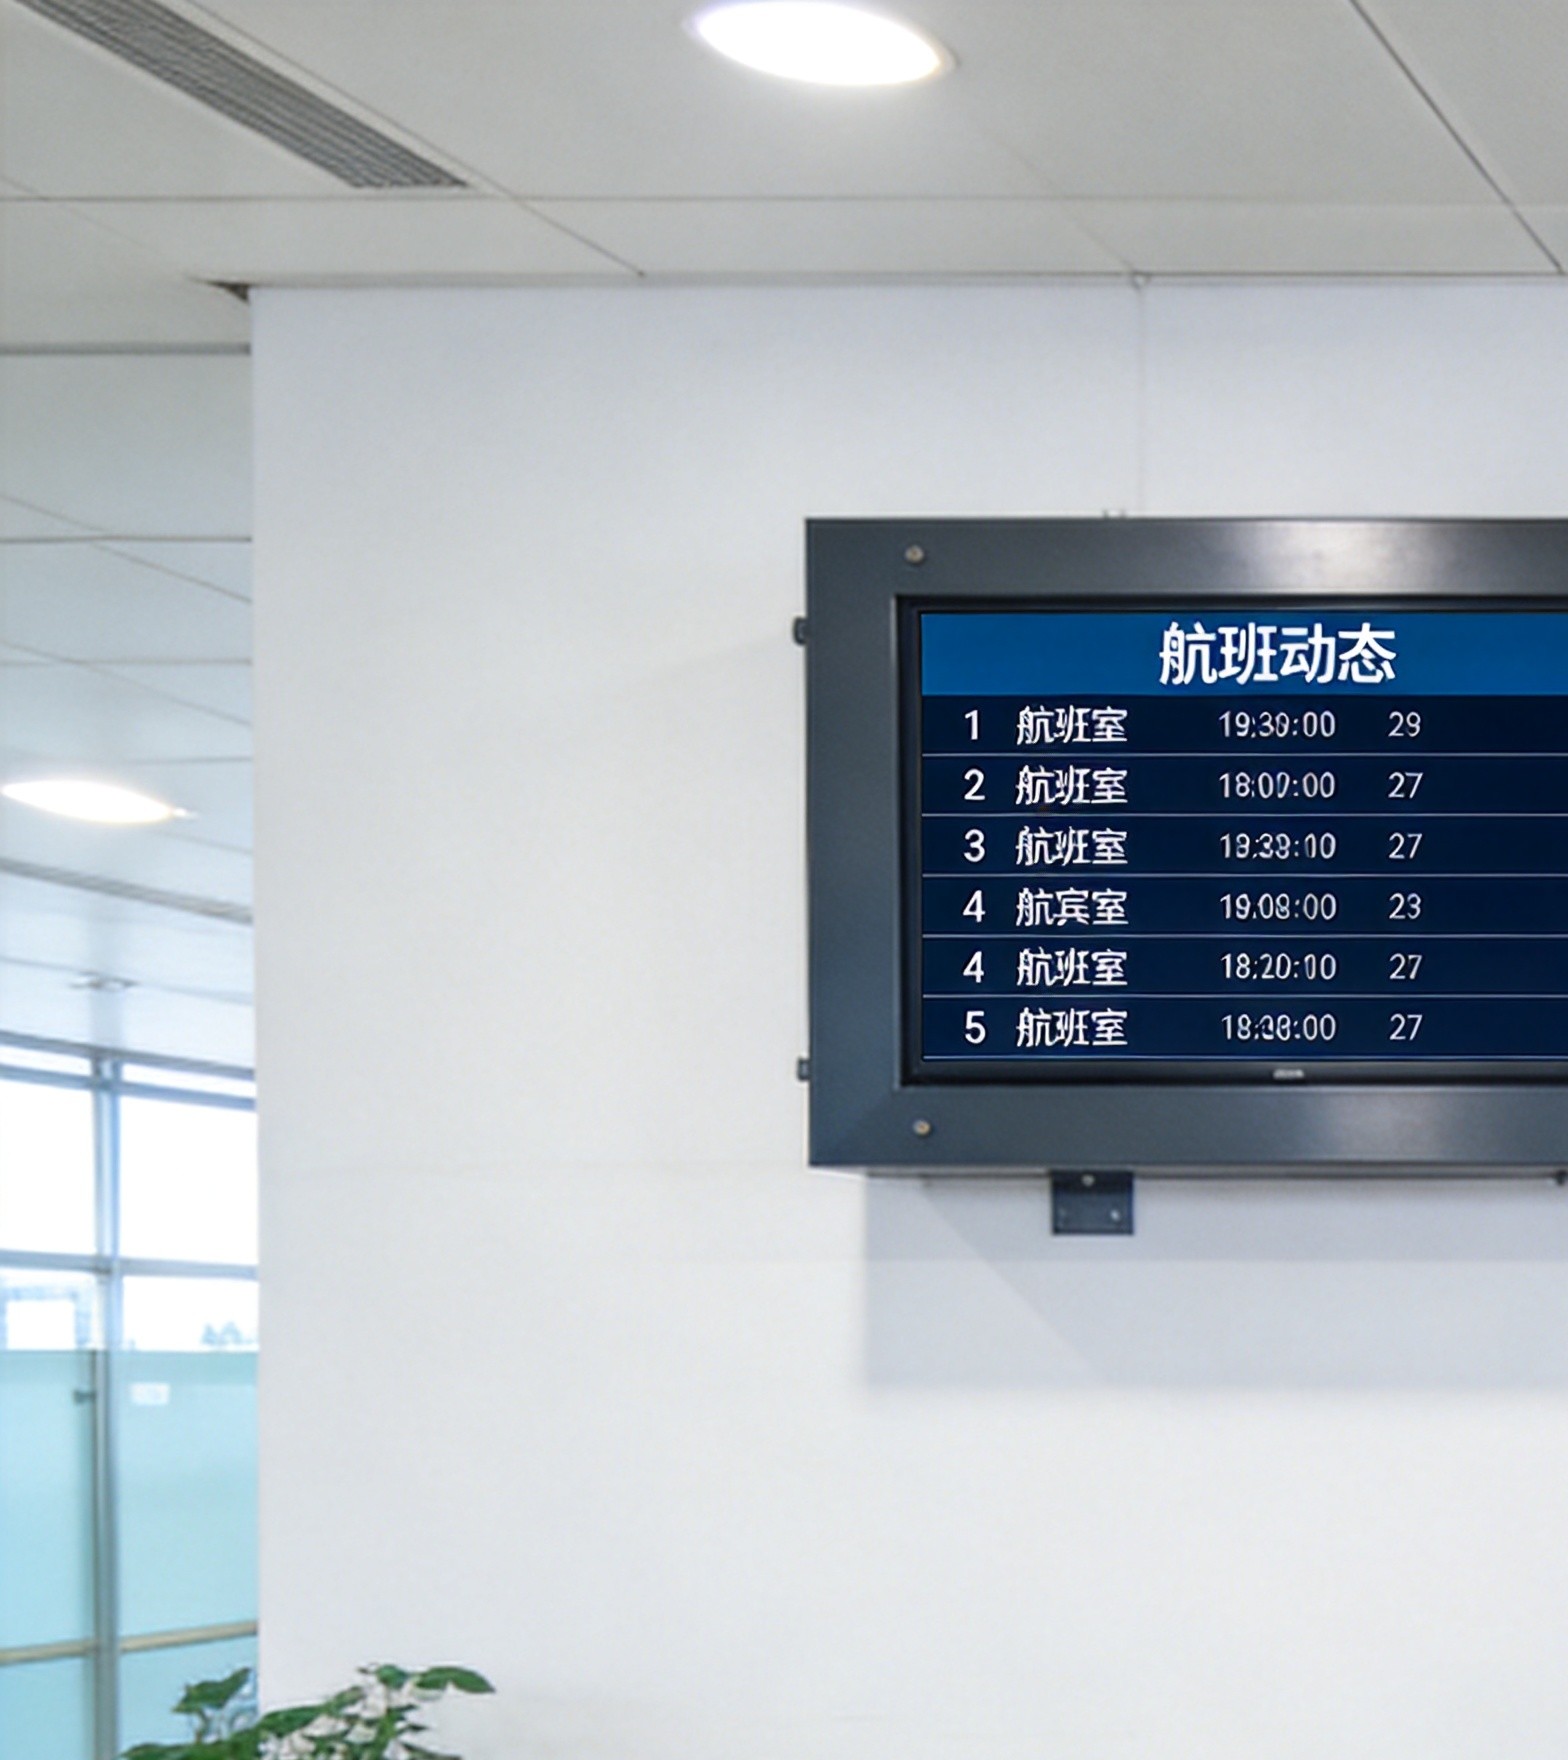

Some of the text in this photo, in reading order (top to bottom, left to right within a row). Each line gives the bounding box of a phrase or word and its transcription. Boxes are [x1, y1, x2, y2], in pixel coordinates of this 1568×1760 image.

[1158, 621, 1397, 685] 航班动态
[964, 709, 979, 741] 1
[1016, 704, 1128, 746] 航班室
[963, 768, 986, 801] 2
[1015, 764, 1129, 806] 航班室
[1388, 771, 1424, 799] 27
[963, 828, 986, 863] 3
[1015, 825, 1129, 867] 航班室
[1388, 832, 1423, 859] 27
[962, 889, 986, 923] 4
[962, 950, 985, 984] 4
[1016, 946, 1128, 987] 航班室
[1389, 952, 1423, 980] 27
[964, 1010, 986, 1045] 5
[1015, 1006, 1128, 1048] 航班室
[1389, 1013, 1423, 1041] 27
